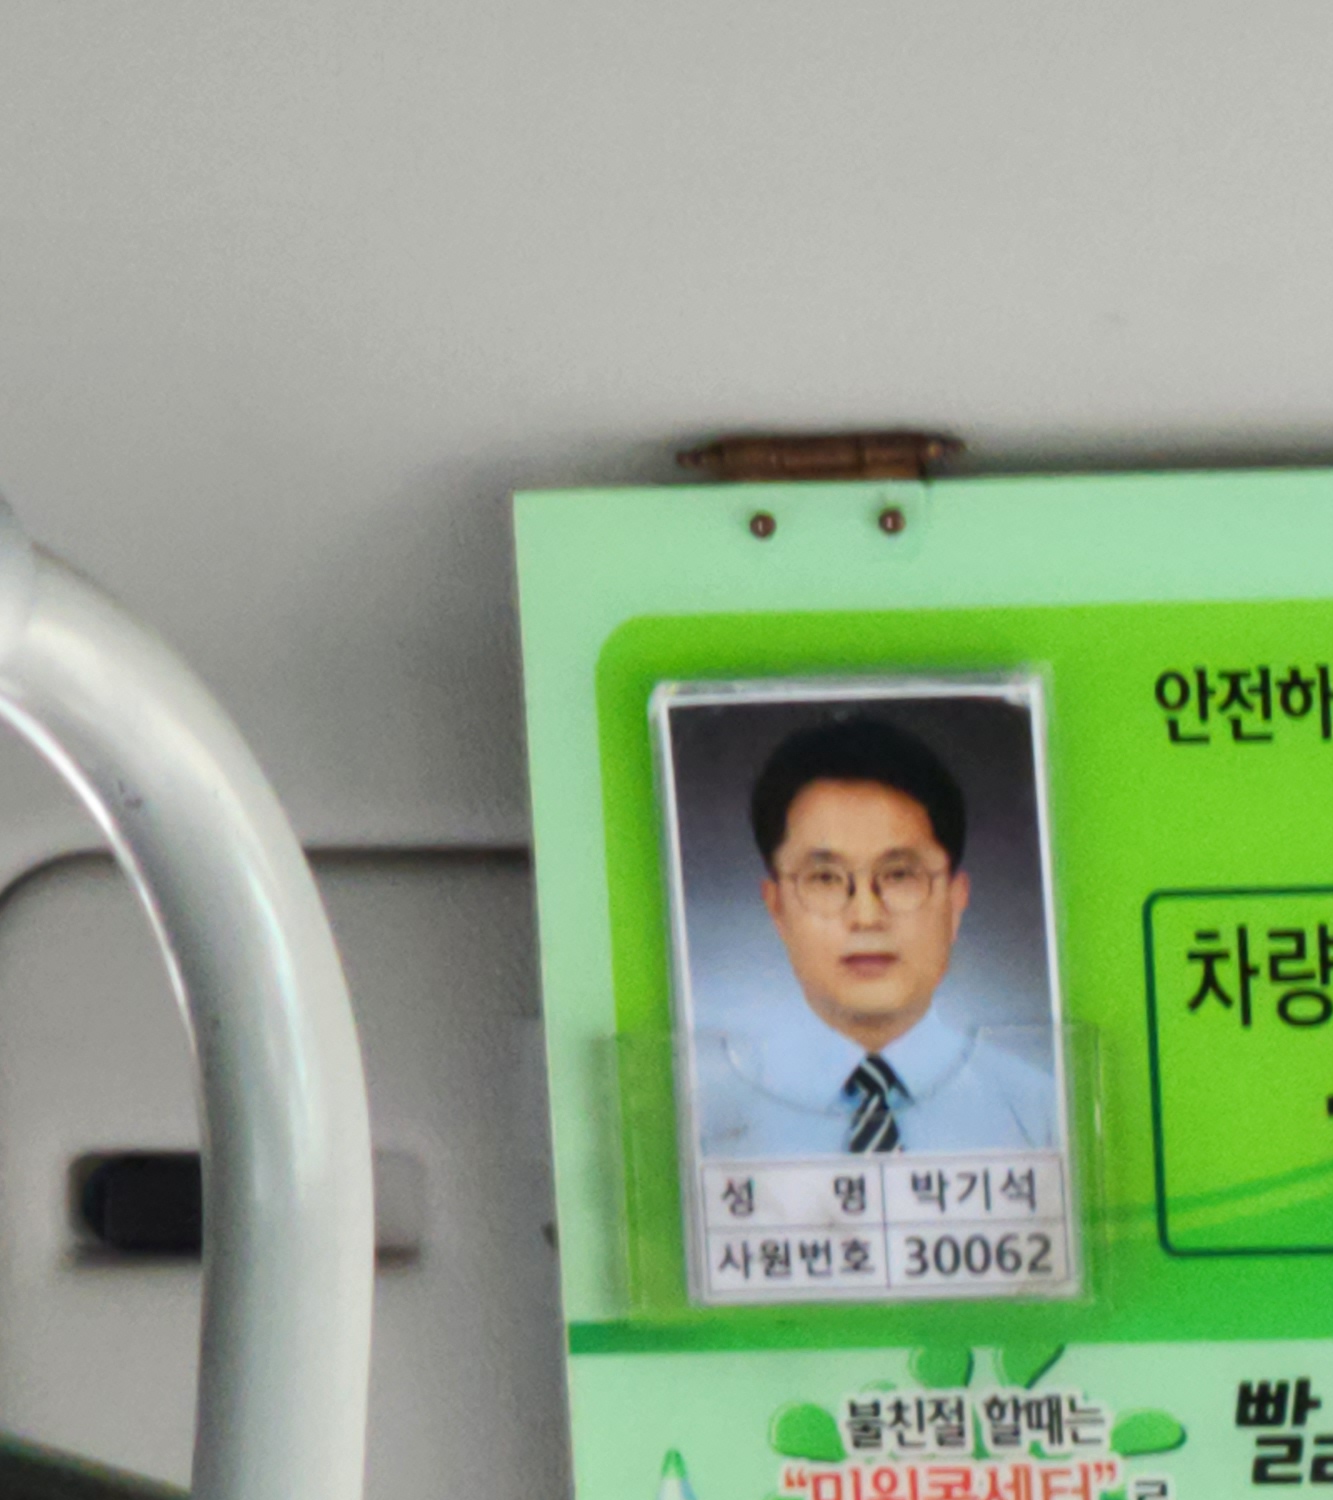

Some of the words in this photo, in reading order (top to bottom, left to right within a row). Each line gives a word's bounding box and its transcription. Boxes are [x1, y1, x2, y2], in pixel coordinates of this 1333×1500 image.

[910, 1166, 1038, 1213] 박기석
[717, 1236, 876, 1280] 사원번호
[903, 1231, 1053, 1277] 30062
[845, 1396, 967, 1447] 불친절
[982, 1391, 1106, 1446] 할때는
